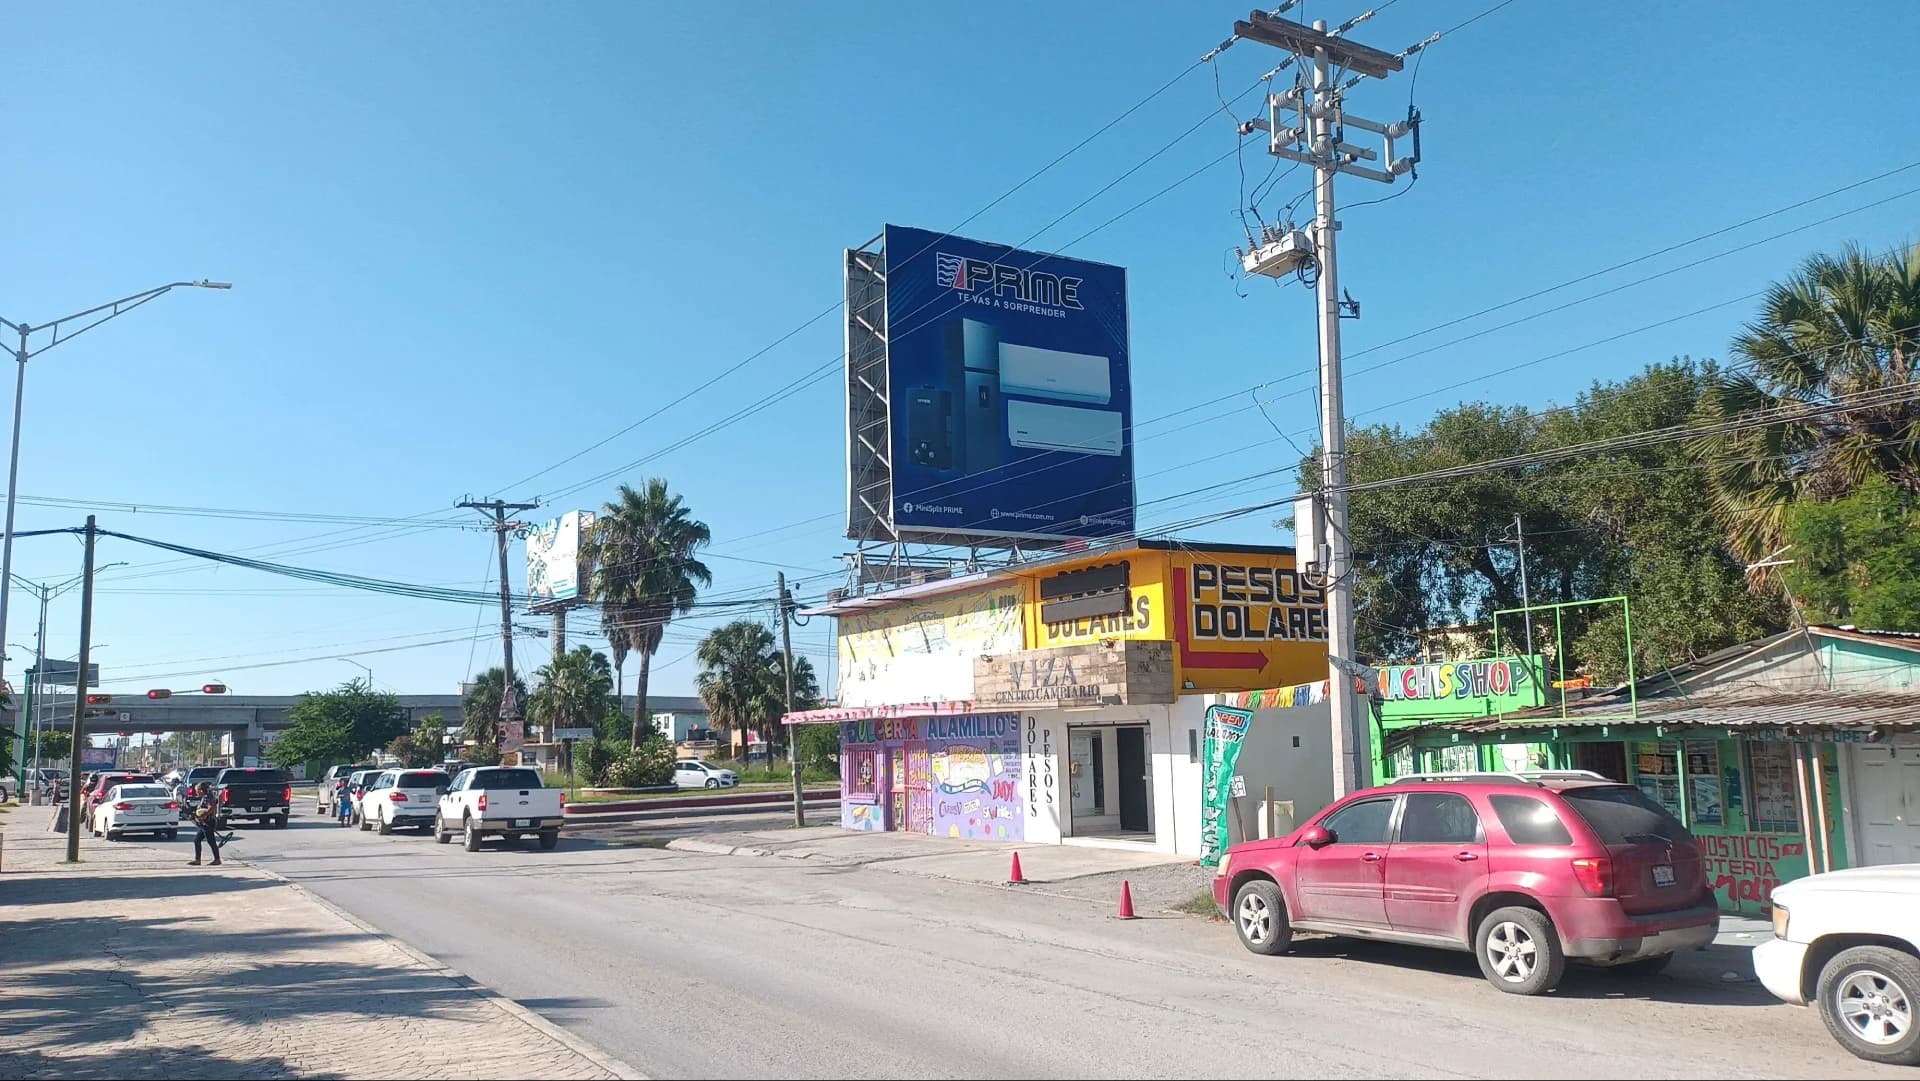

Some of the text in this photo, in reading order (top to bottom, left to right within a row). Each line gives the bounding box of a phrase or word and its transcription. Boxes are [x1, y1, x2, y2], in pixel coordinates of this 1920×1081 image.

[965, 258, 1085, 310] PRIME
[958, 292, 1066, 319] TE VAS A SORPRENDER
[943, 506, 963, 515] PRIME
[1192, 563, 1326, 606] PESOS
[1193, 604, 1328, 641] DOLARE
[1010, 655, 1078, 690] VIZA
[1456, 661, 1529, 698] SHOP
[995, 684, 1100, 703] CENTRO CAMBIARIO
[927, 711, 1018, 740] ALAMILLO'S
[1027, 715, 1038, 818] DOLARES
[1043, 728, 1054, 804] PESOS
[1695, 836, 1780, 861] NOSTICOS
